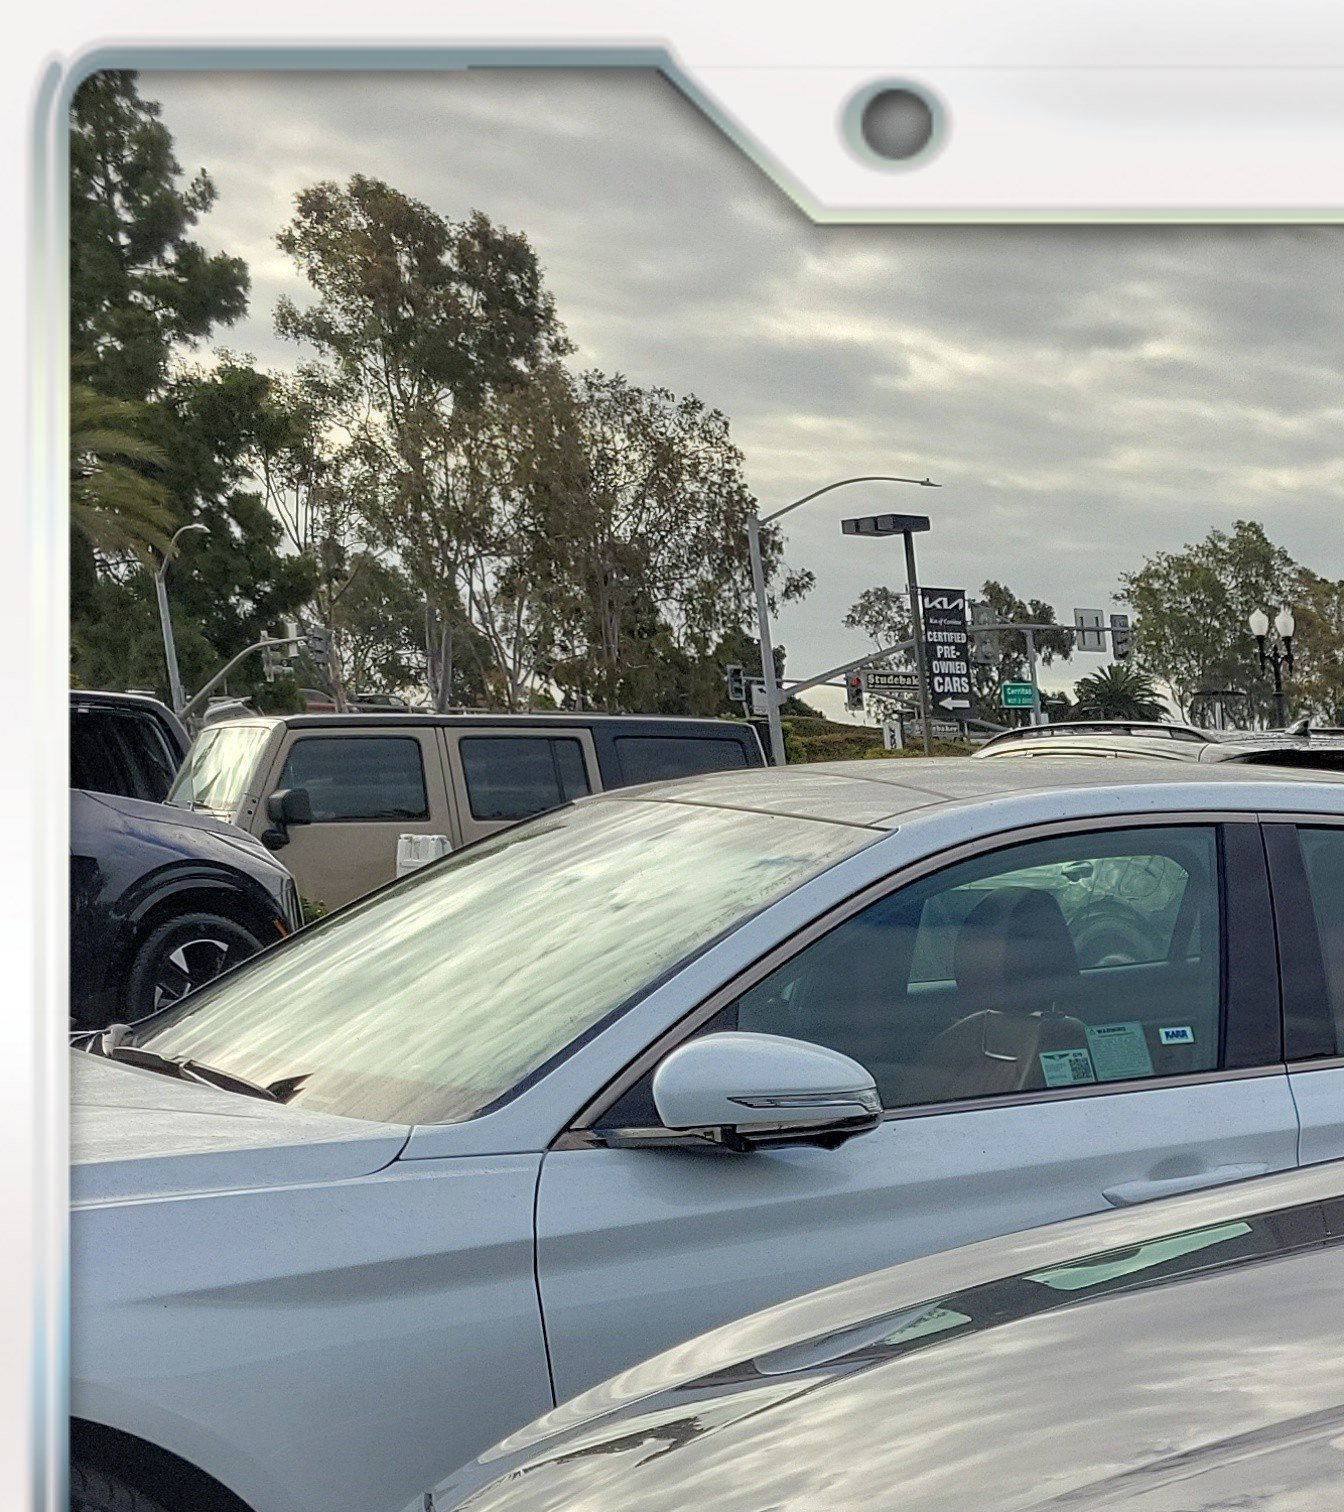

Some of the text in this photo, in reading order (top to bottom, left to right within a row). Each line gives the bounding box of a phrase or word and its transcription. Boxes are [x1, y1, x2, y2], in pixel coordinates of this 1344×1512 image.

[927, 630, 967, 643] CERTIFIED
[936, 645, 960, 659] PRE-
[932, 661, 967, 675] OWNED
[867, 673, 919, 685] Studebak
[934, 676, 970, 694] CARS
[1164, 1029, 1188, 1041] KARR
